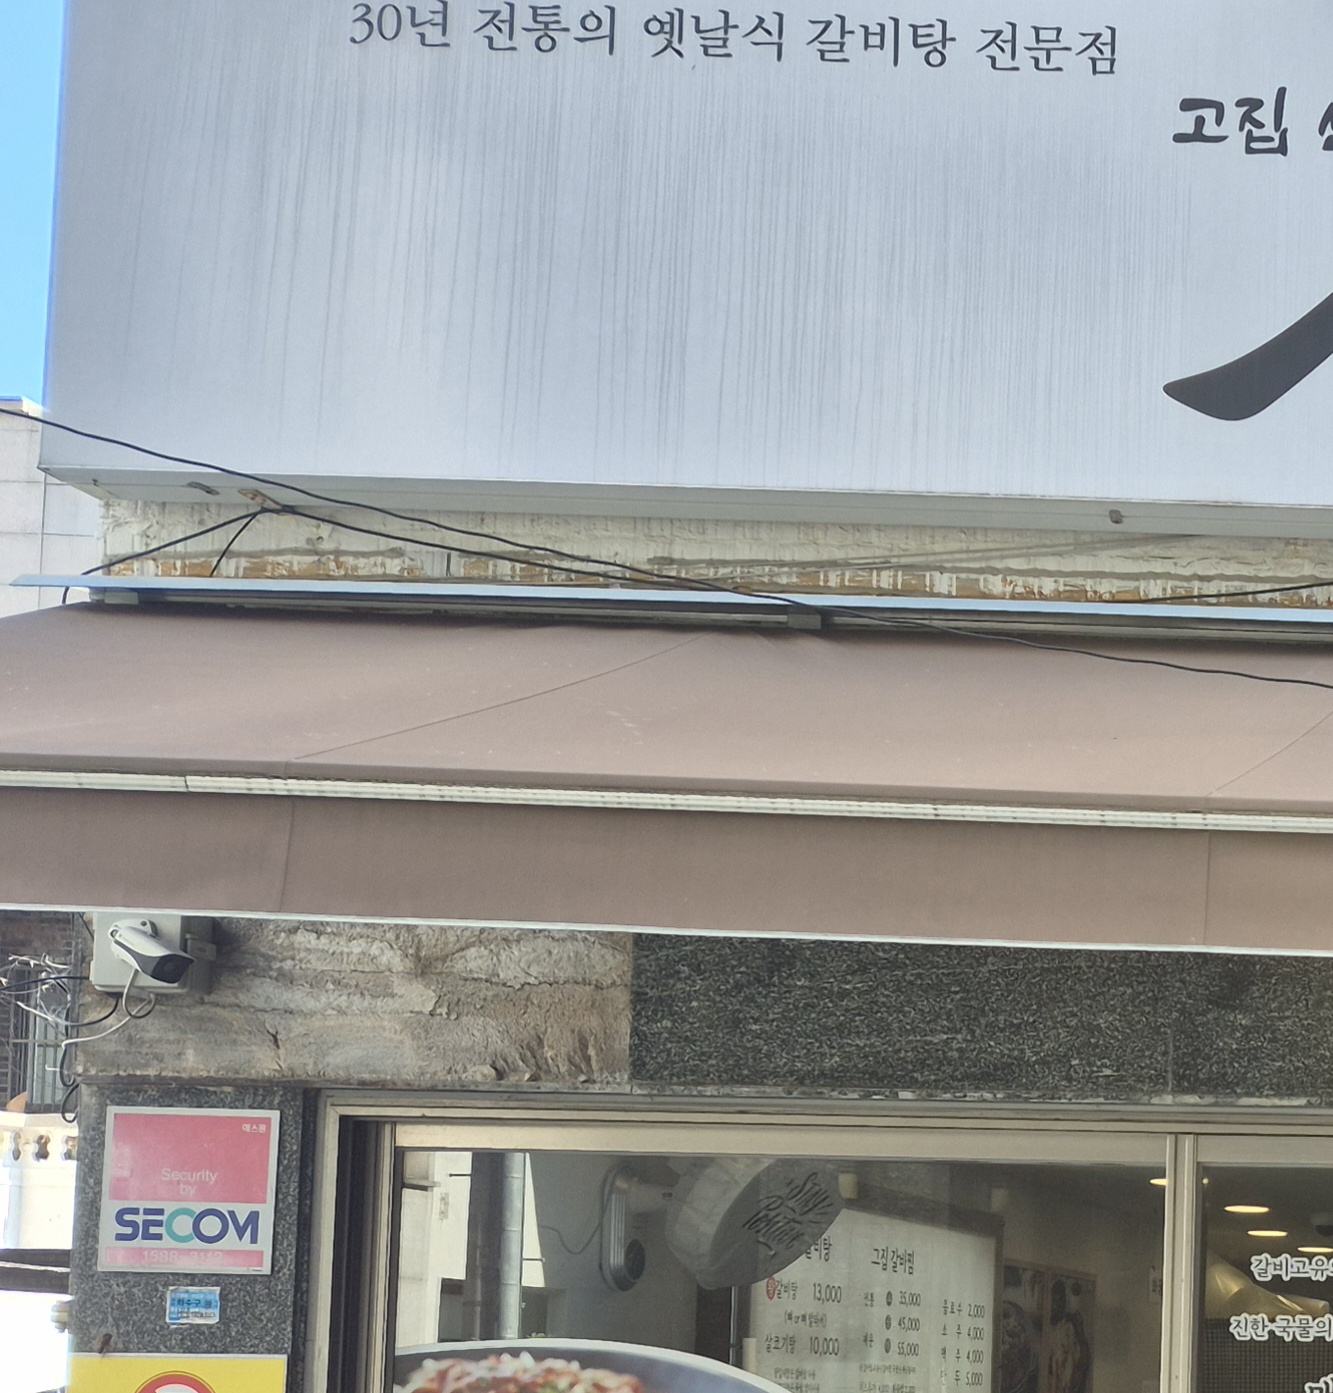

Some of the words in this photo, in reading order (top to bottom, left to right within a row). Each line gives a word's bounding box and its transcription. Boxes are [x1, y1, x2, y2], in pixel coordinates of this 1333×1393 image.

[348, 1, 452, 50] 30년
[473, 2, 617, 56] 전통의
[643, 8, 787, 62] 옛날식
[806, 15, 957, 69] 갈비탕
[976, 23, 1120, 77] 전문점
[1172, 87, 1290, 155] 고집
[161, 1167, 218, 1184] Security
[180, 1183, 197, 1196] by
[114, 1207, 260, 1245] SECOM
[812, 1283, 842, 1304] 13,000
[1230, 1315, 1270, 1340] 진한
[809, 1336, 840, 1356] 10,000
